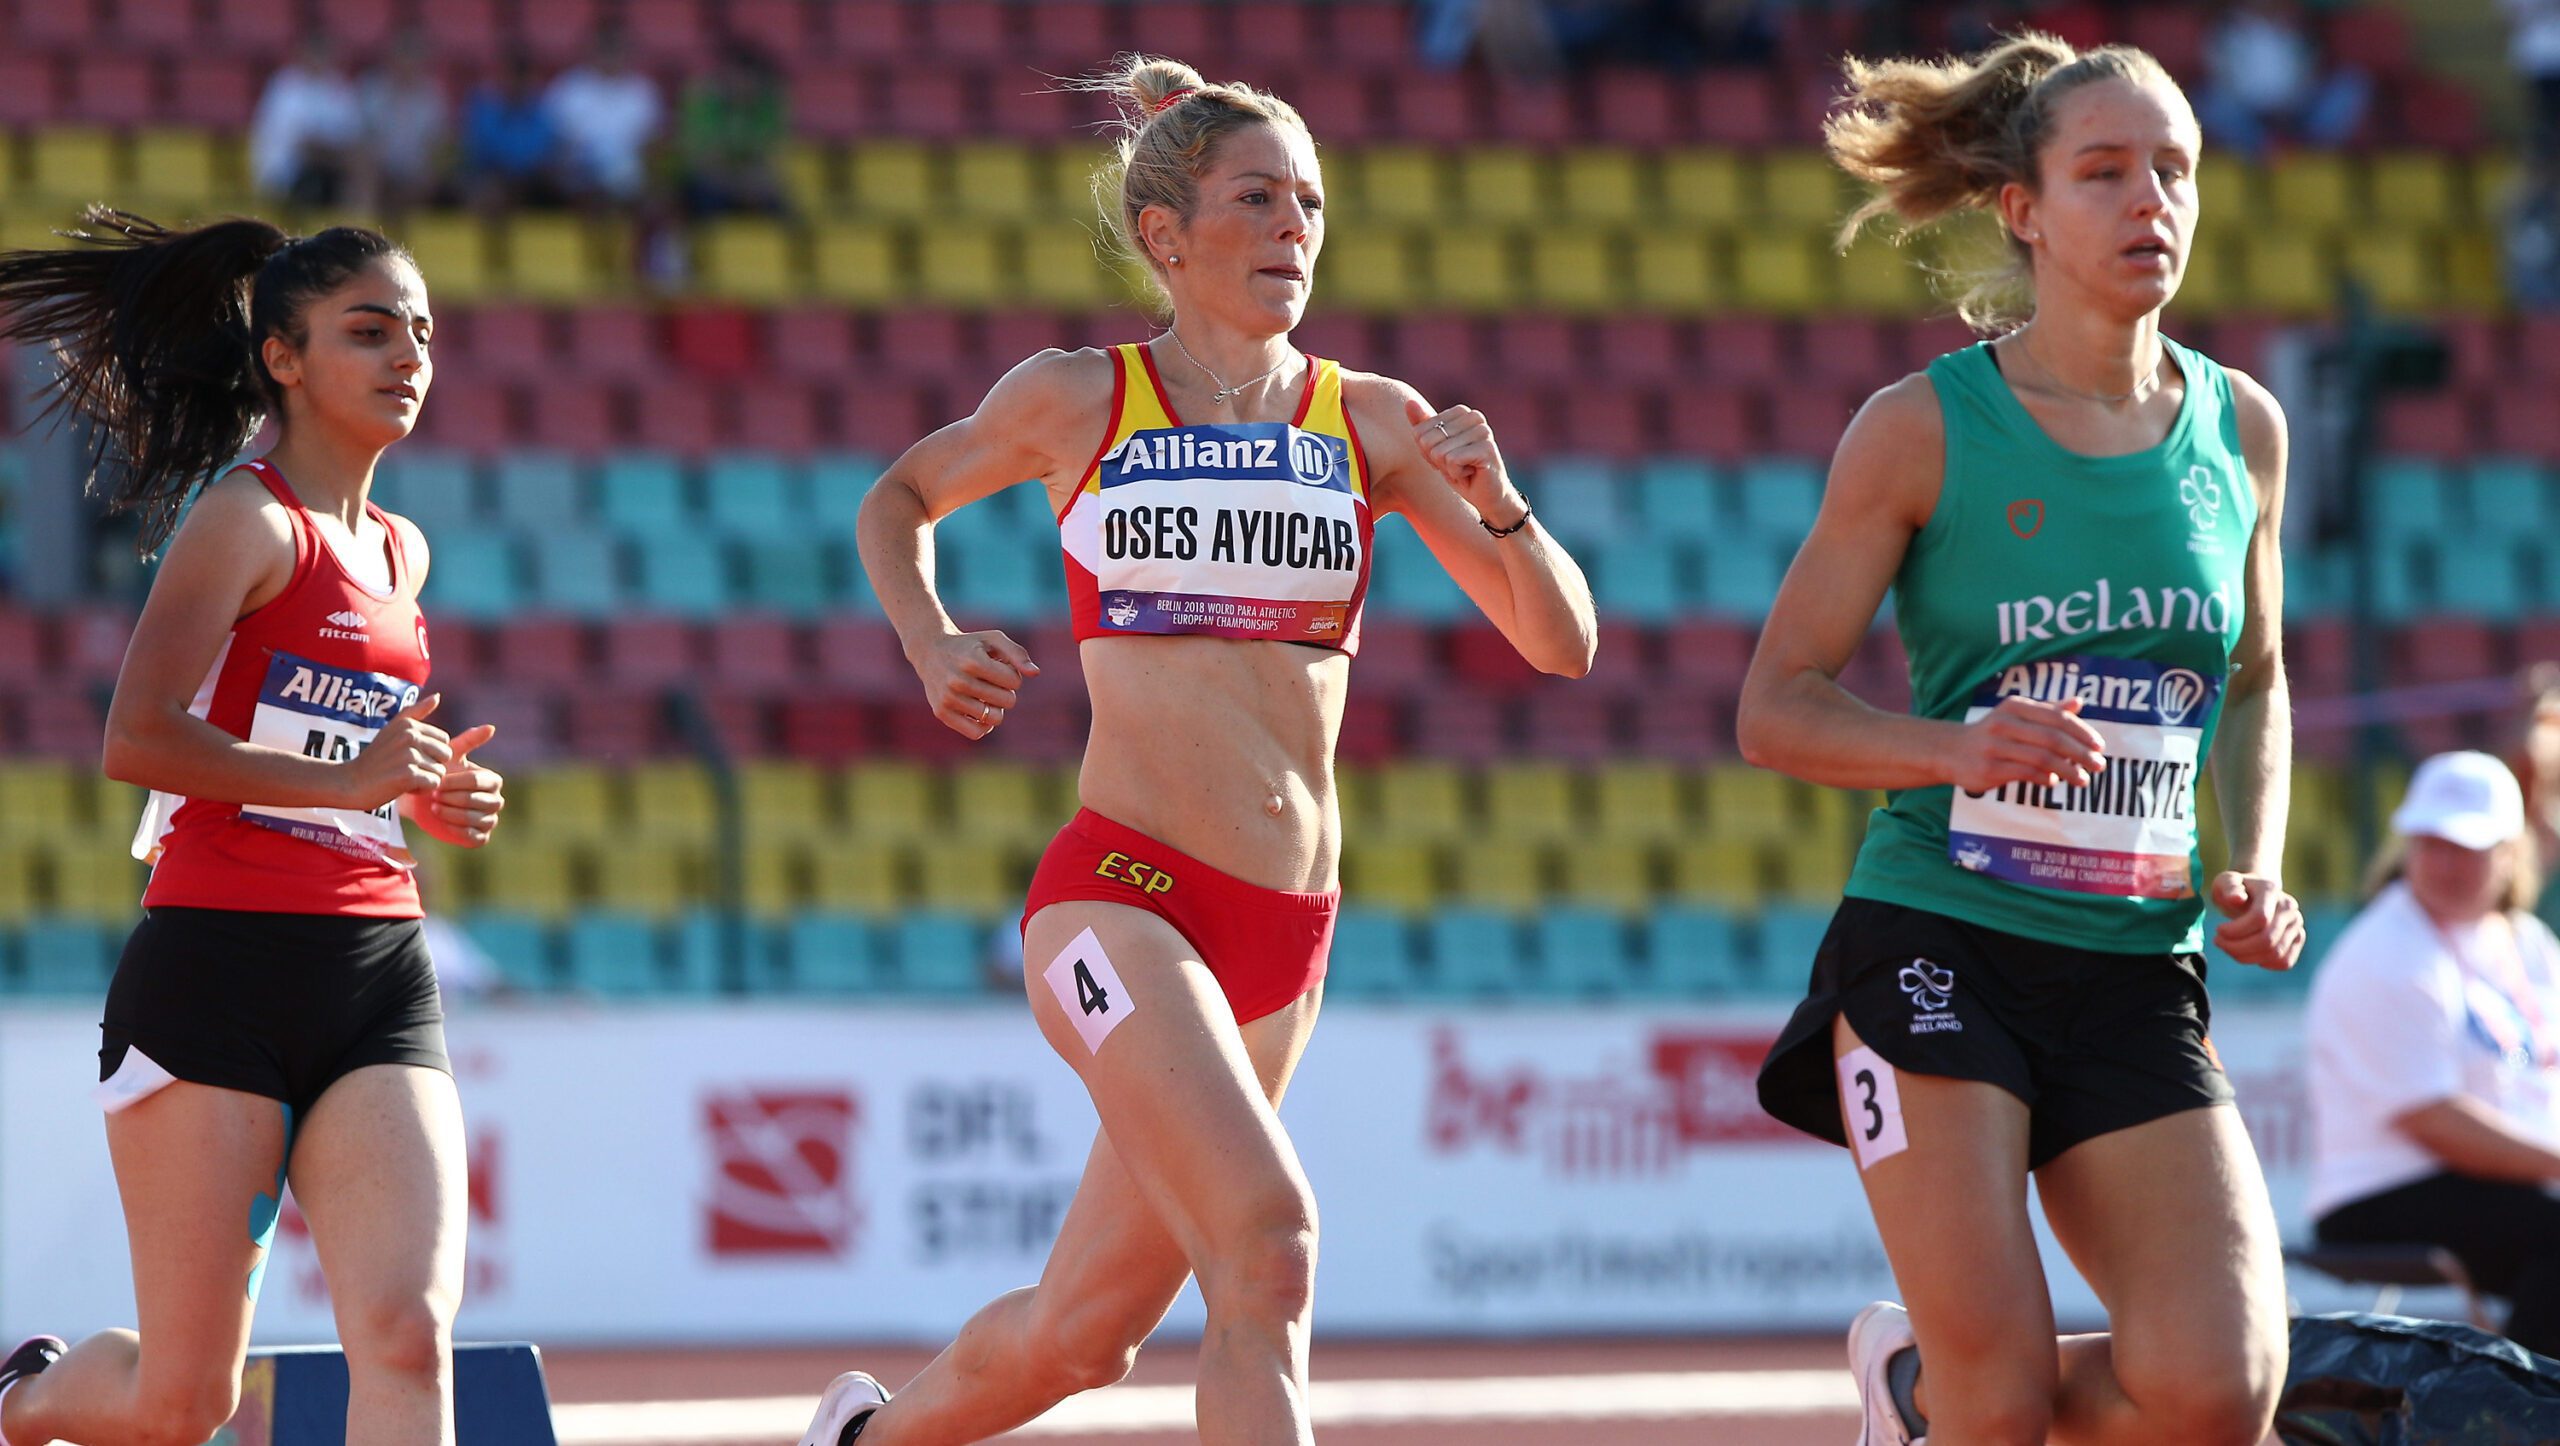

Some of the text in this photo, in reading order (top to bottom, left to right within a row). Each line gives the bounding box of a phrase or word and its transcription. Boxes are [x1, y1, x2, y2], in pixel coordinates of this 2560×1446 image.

[1121, 434, 1278, 475] Allianz
[1105, 505, 1355, 572] OSES AYUCAR
[1157, 600, 1297, 619] BERLIN 2018 WOLRD PARA ATHLETICS
[1173, 613, 1279, 631] EUROPEAN CHAMPIONSHIPS
[318, 627, 370, 643] fitcom
[280, 666, 397, 718] Allianz
[1996, 661, 2153, 713] Allianz
[1096, 851, 1174, 894] ESP
[1074, 958, 1110, 1017] 4
[1855, 1069, 1884, 1141] 3
